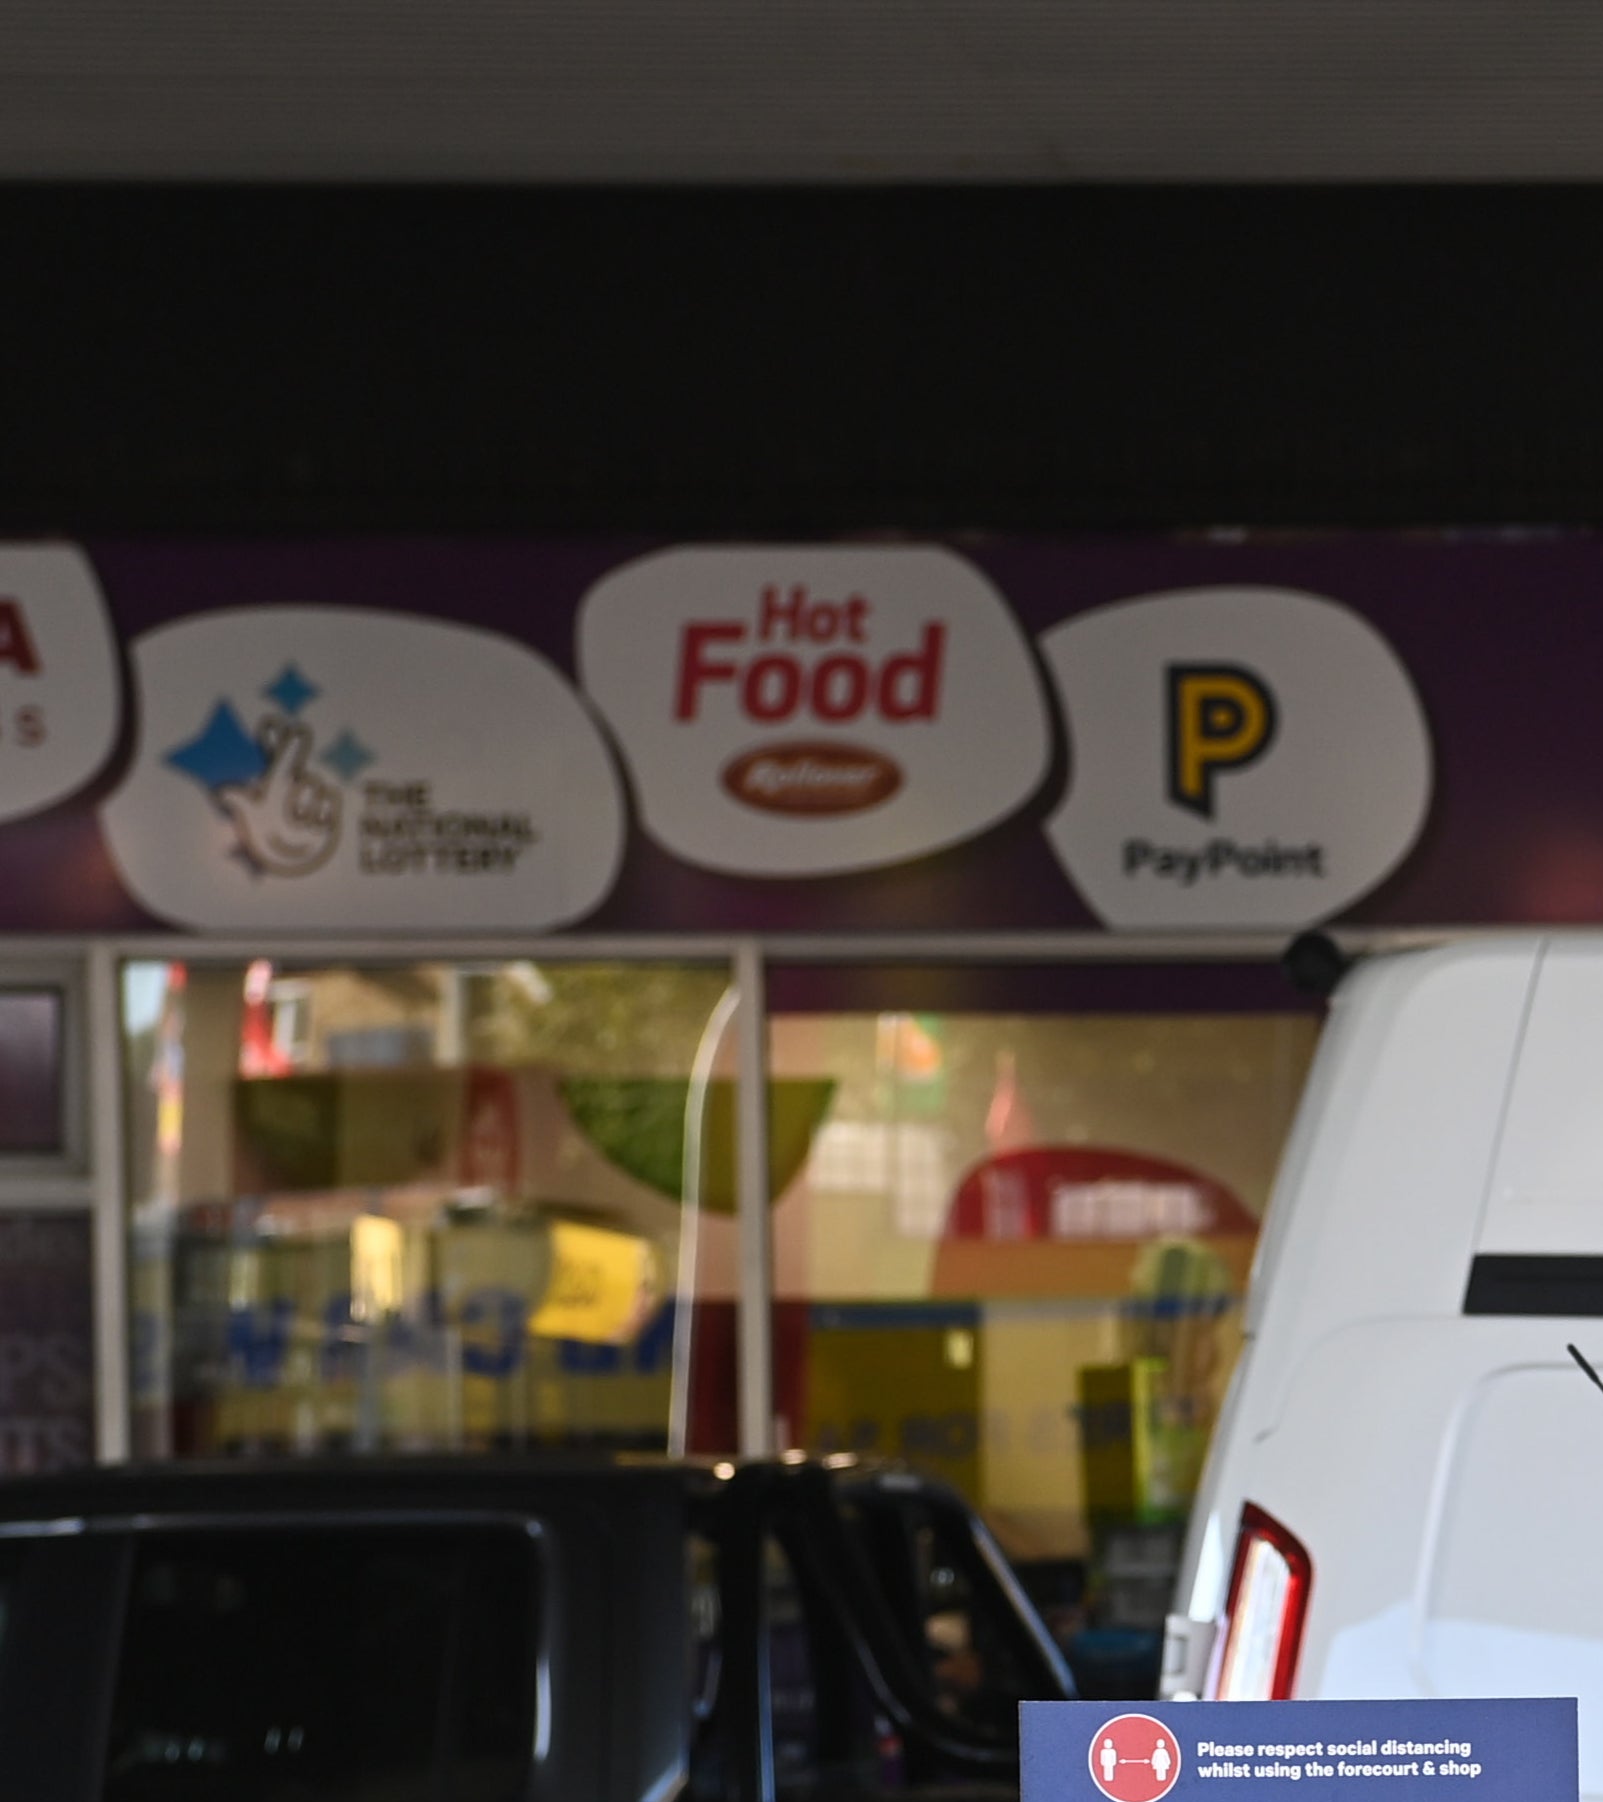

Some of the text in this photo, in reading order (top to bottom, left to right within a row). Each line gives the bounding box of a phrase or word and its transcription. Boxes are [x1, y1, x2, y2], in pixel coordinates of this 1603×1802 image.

[759, 588, 868, 644] Hot
[674, 623, 945, 725] Food
[357, 813, 539, 846] NATIONAL
[359, 842, 525, 876] LOTTERY
[1123, 840, 1327, 886] PayPoint
[1197, 1738, 1472, 1761] Please respect social distancing
[1197, 1759, 1482, 1782] whilst using the forecourt & shop
